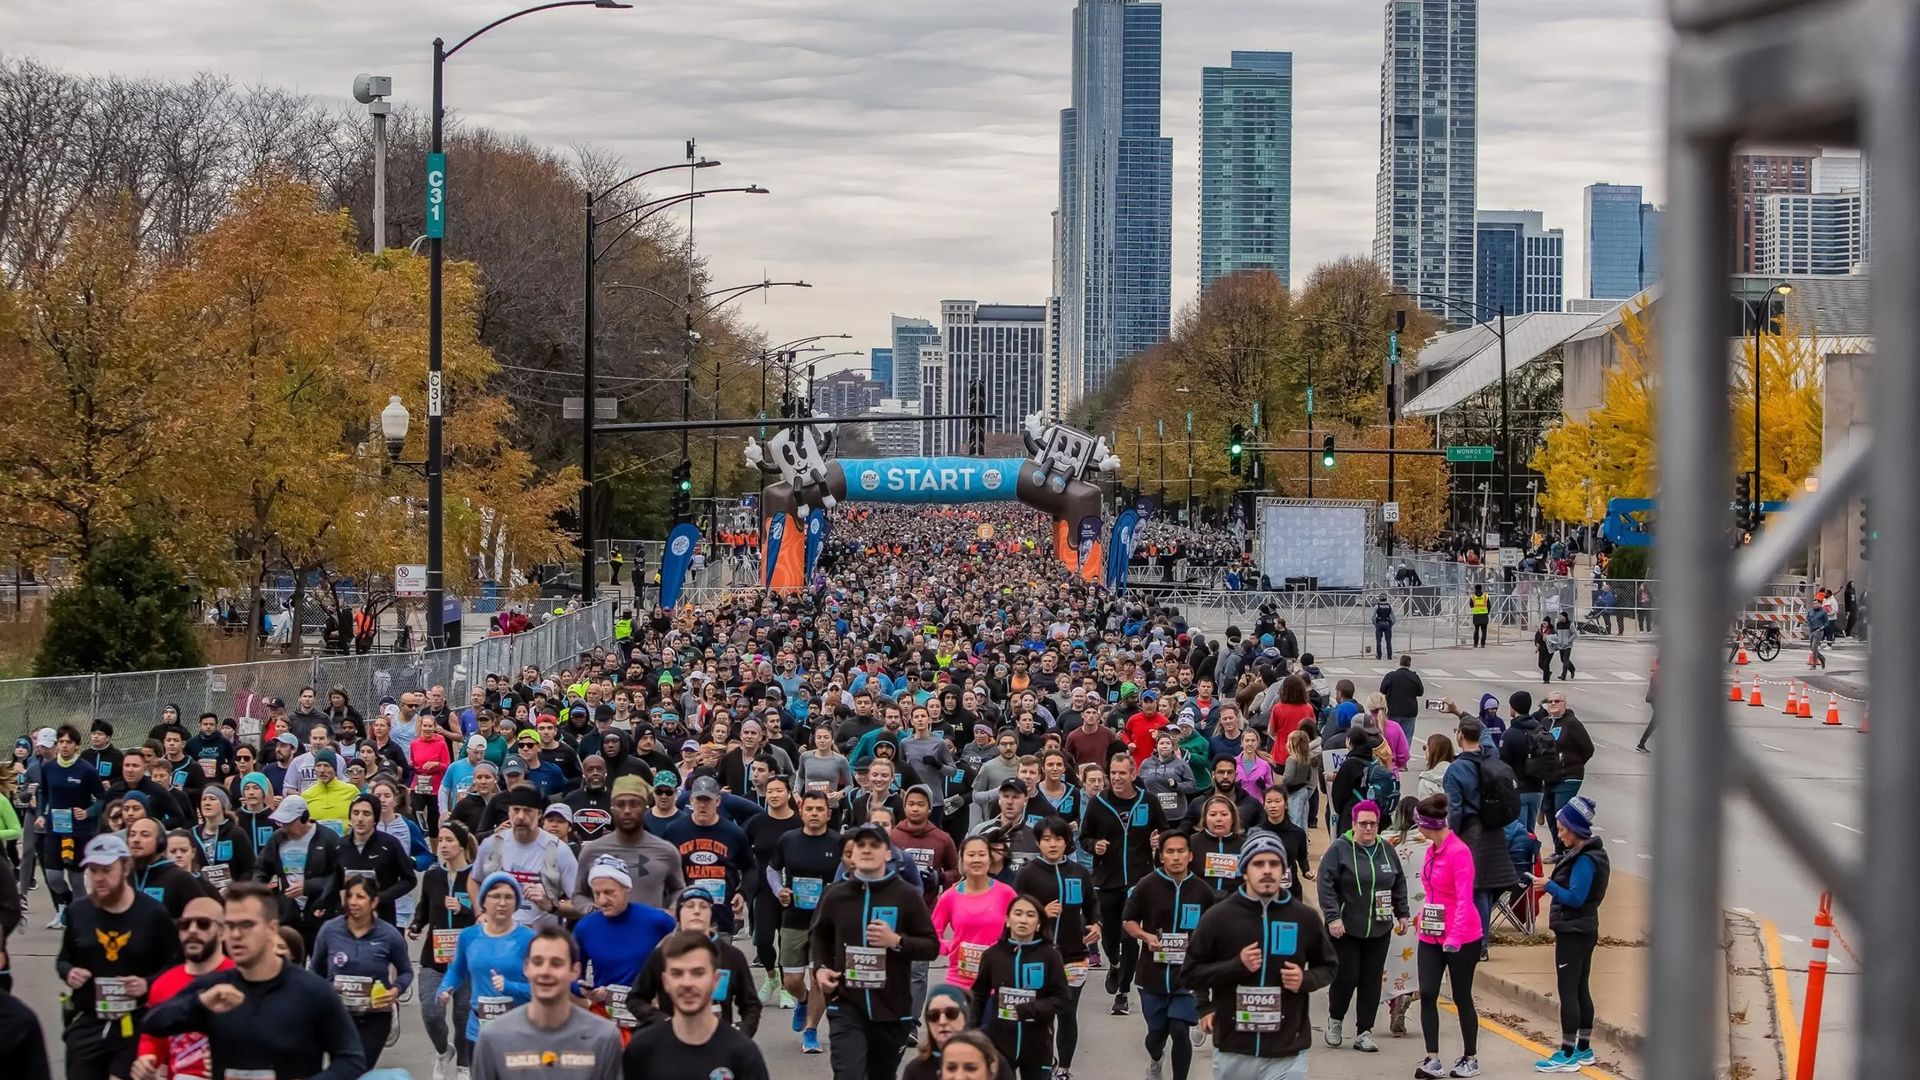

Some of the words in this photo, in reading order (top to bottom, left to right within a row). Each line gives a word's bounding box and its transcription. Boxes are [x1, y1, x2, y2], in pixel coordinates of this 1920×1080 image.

[429, 170, 443, 221] C31
[430, 375, 439, 412] C31
[887, 467, 975, 491] START
[1386, 511, 1397, 519] 30
[982, 528, 989, 538] E
[679, 840, 694, 855] NEW
[695, 838, 713, 851] YORK
[713, 840, 728, 857] CITY
[695, 854, 712, 862] 2014
[853, 954, 878, 965] 9595
[1242, 994, 1275, 1005] 10966
